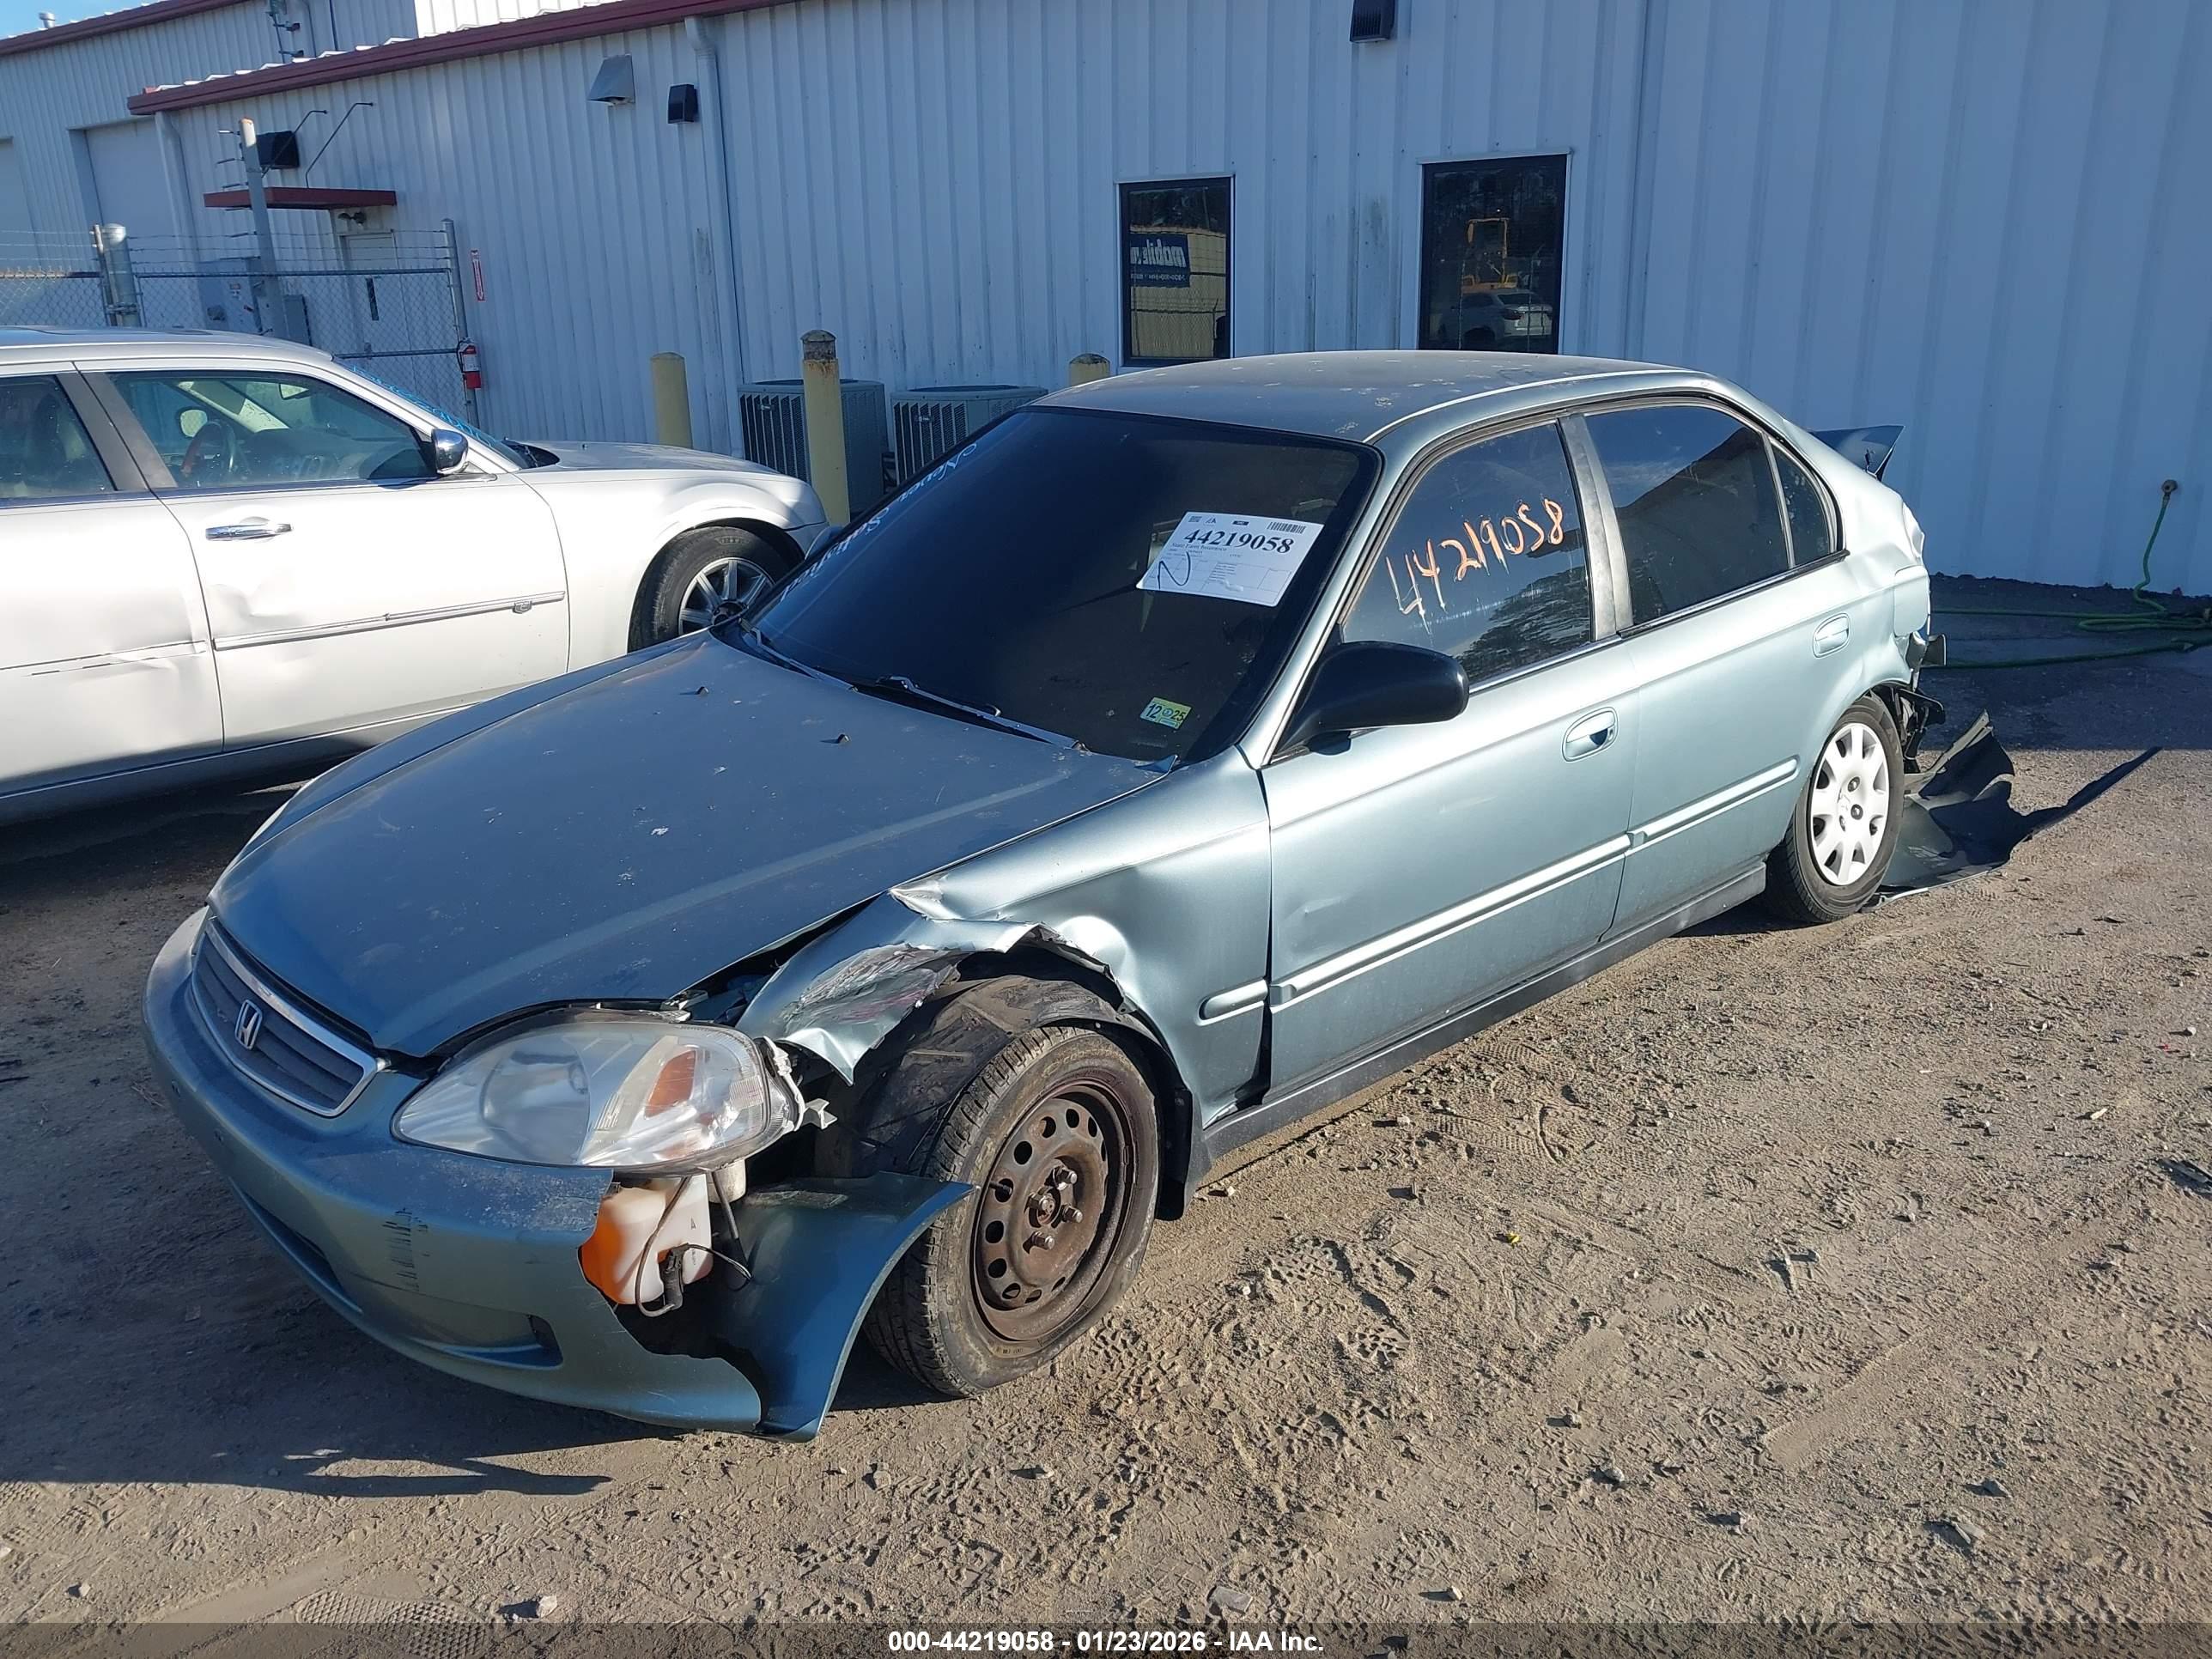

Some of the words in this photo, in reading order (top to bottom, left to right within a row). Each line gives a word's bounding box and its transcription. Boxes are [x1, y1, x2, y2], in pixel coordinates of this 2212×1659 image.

[897, 443, 977, 502] Never
[1184, 528, 1295, 554] 44219058
[1385, 497, 1565, 634] 44219058
[1146, 703, 1163, 719] 12
[1170, 709, 1187, 721] 25
